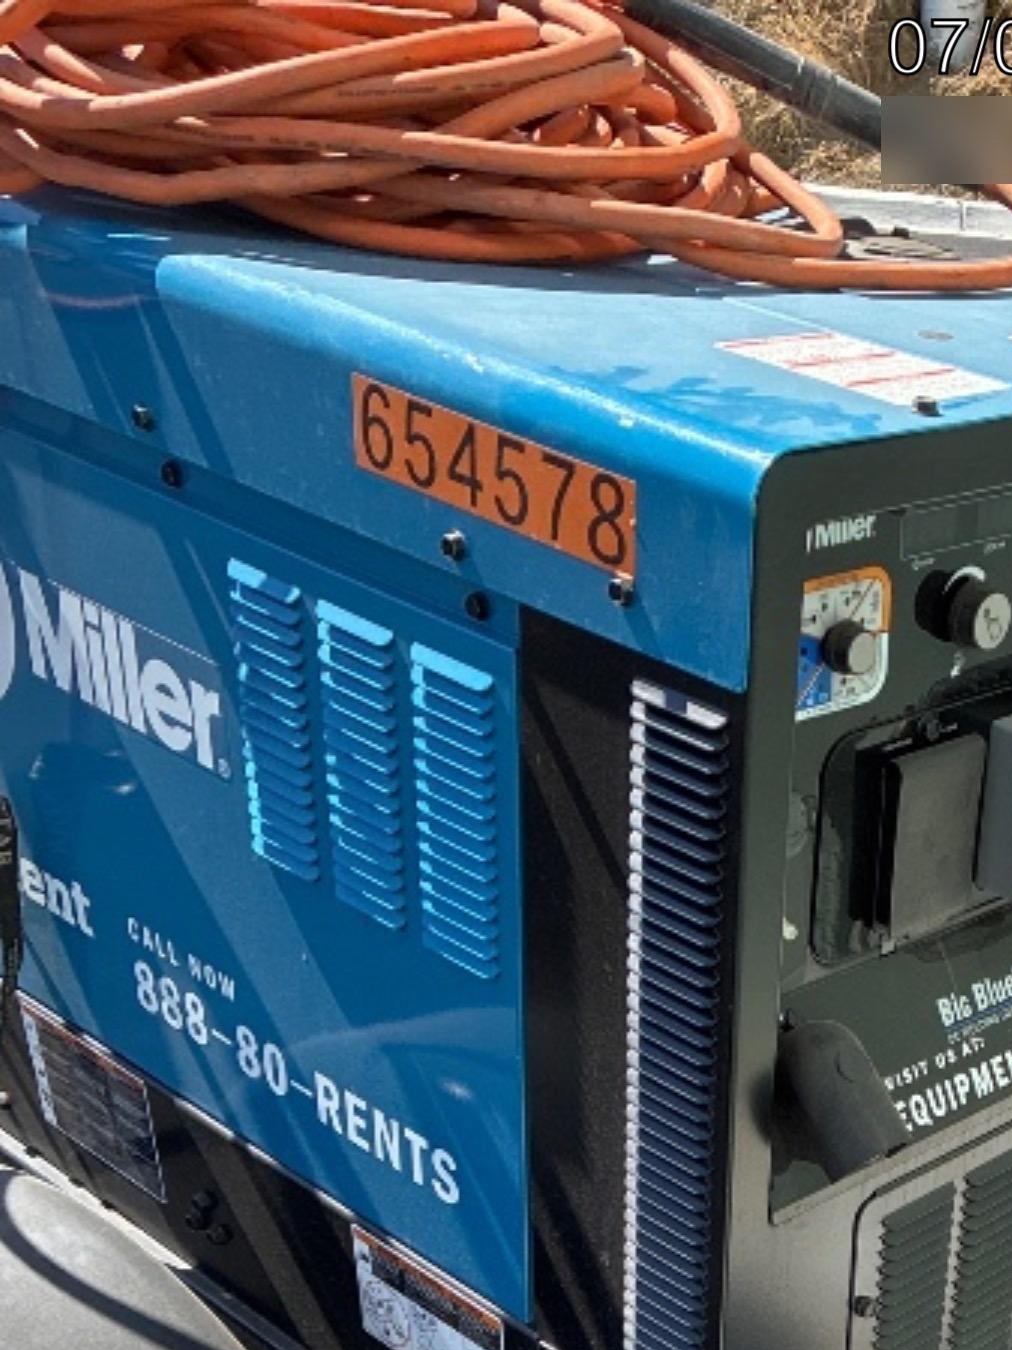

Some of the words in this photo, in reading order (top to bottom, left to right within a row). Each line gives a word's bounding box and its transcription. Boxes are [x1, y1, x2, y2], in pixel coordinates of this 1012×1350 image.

[362, 383, 626, 565] 654578
[18, 857, 94, 937] ent
[128, 917, 179, 967] CALL
[188, 953, 235, 1003] NOW
[936, 992, 973, 1026] Big
[134, 960, 460, 1204] 888-80-RENTS
